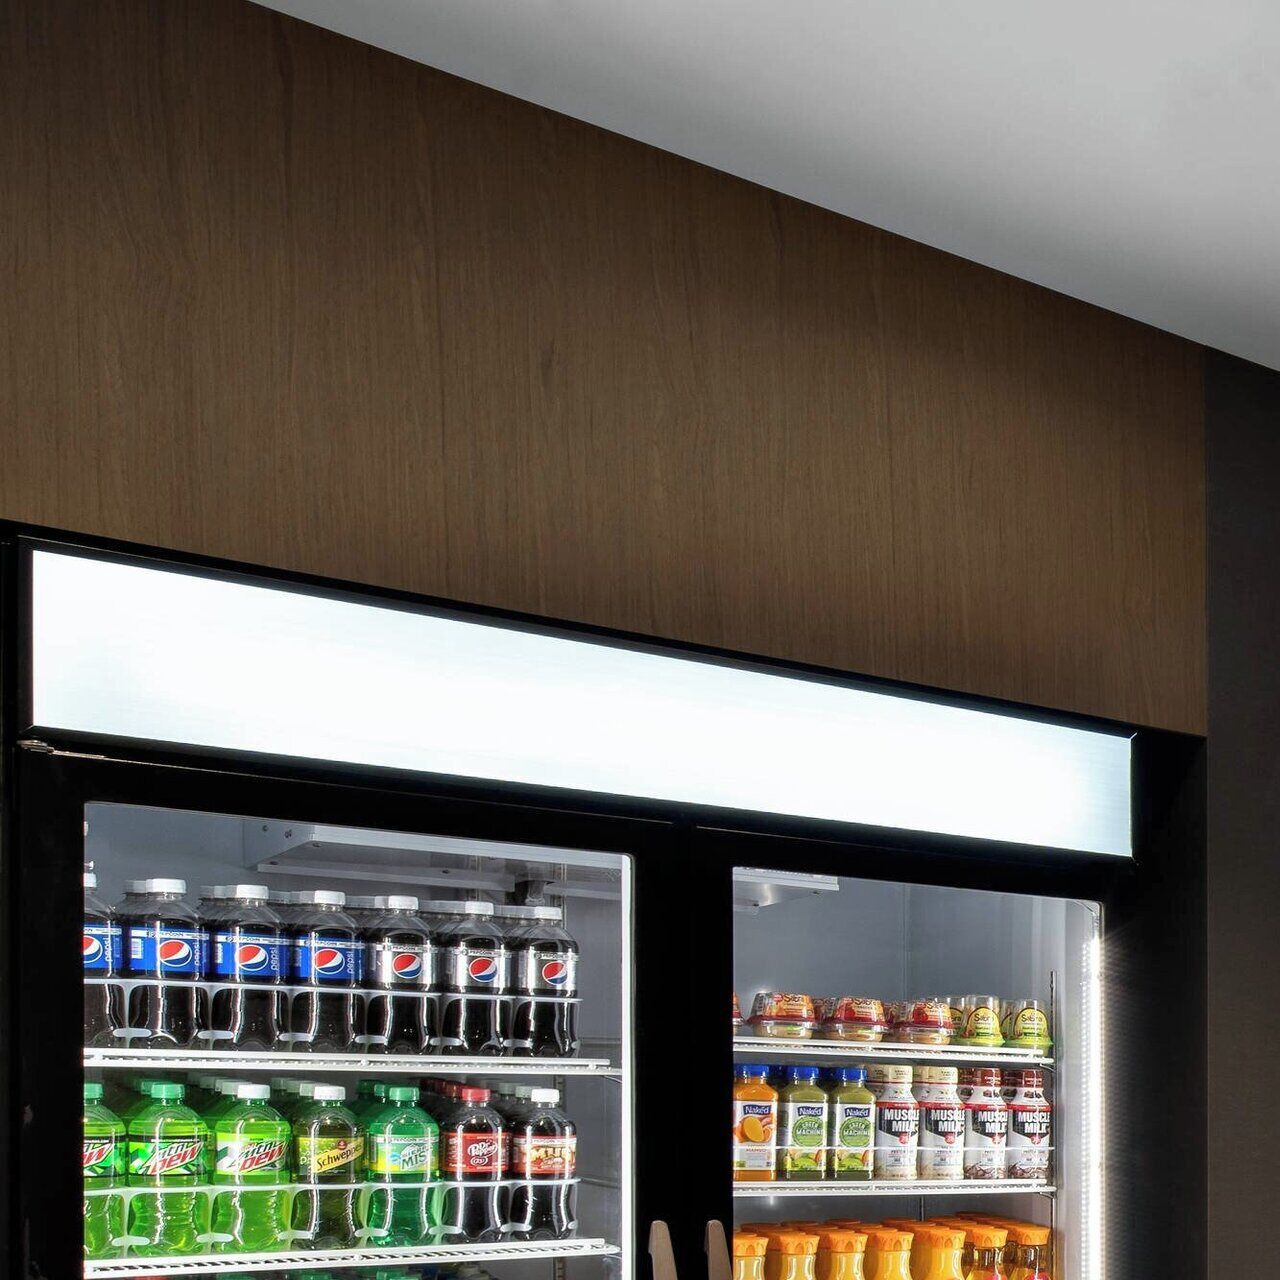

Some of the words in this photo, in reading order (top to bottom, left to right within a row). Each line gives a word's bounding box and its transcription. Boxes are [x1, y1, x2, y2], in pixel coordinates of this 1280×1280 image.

[884, 1107, 920, 1121] MUSCLE
[931, 1109, 965, 1121] MUSCLE
[978, 1111, 1008, 1123] MUSCLE
[1018, 1111, 1050, 1123] MUSCLE
[892, 1121, 918, 1132] MILK
[938, 1121, 964, 1132] MILK
[985, 1122, 1007, 1133] MILK
[1024, 1122, 1050, 1133] MILK
[240, 1144, 284, 1172] DEW
